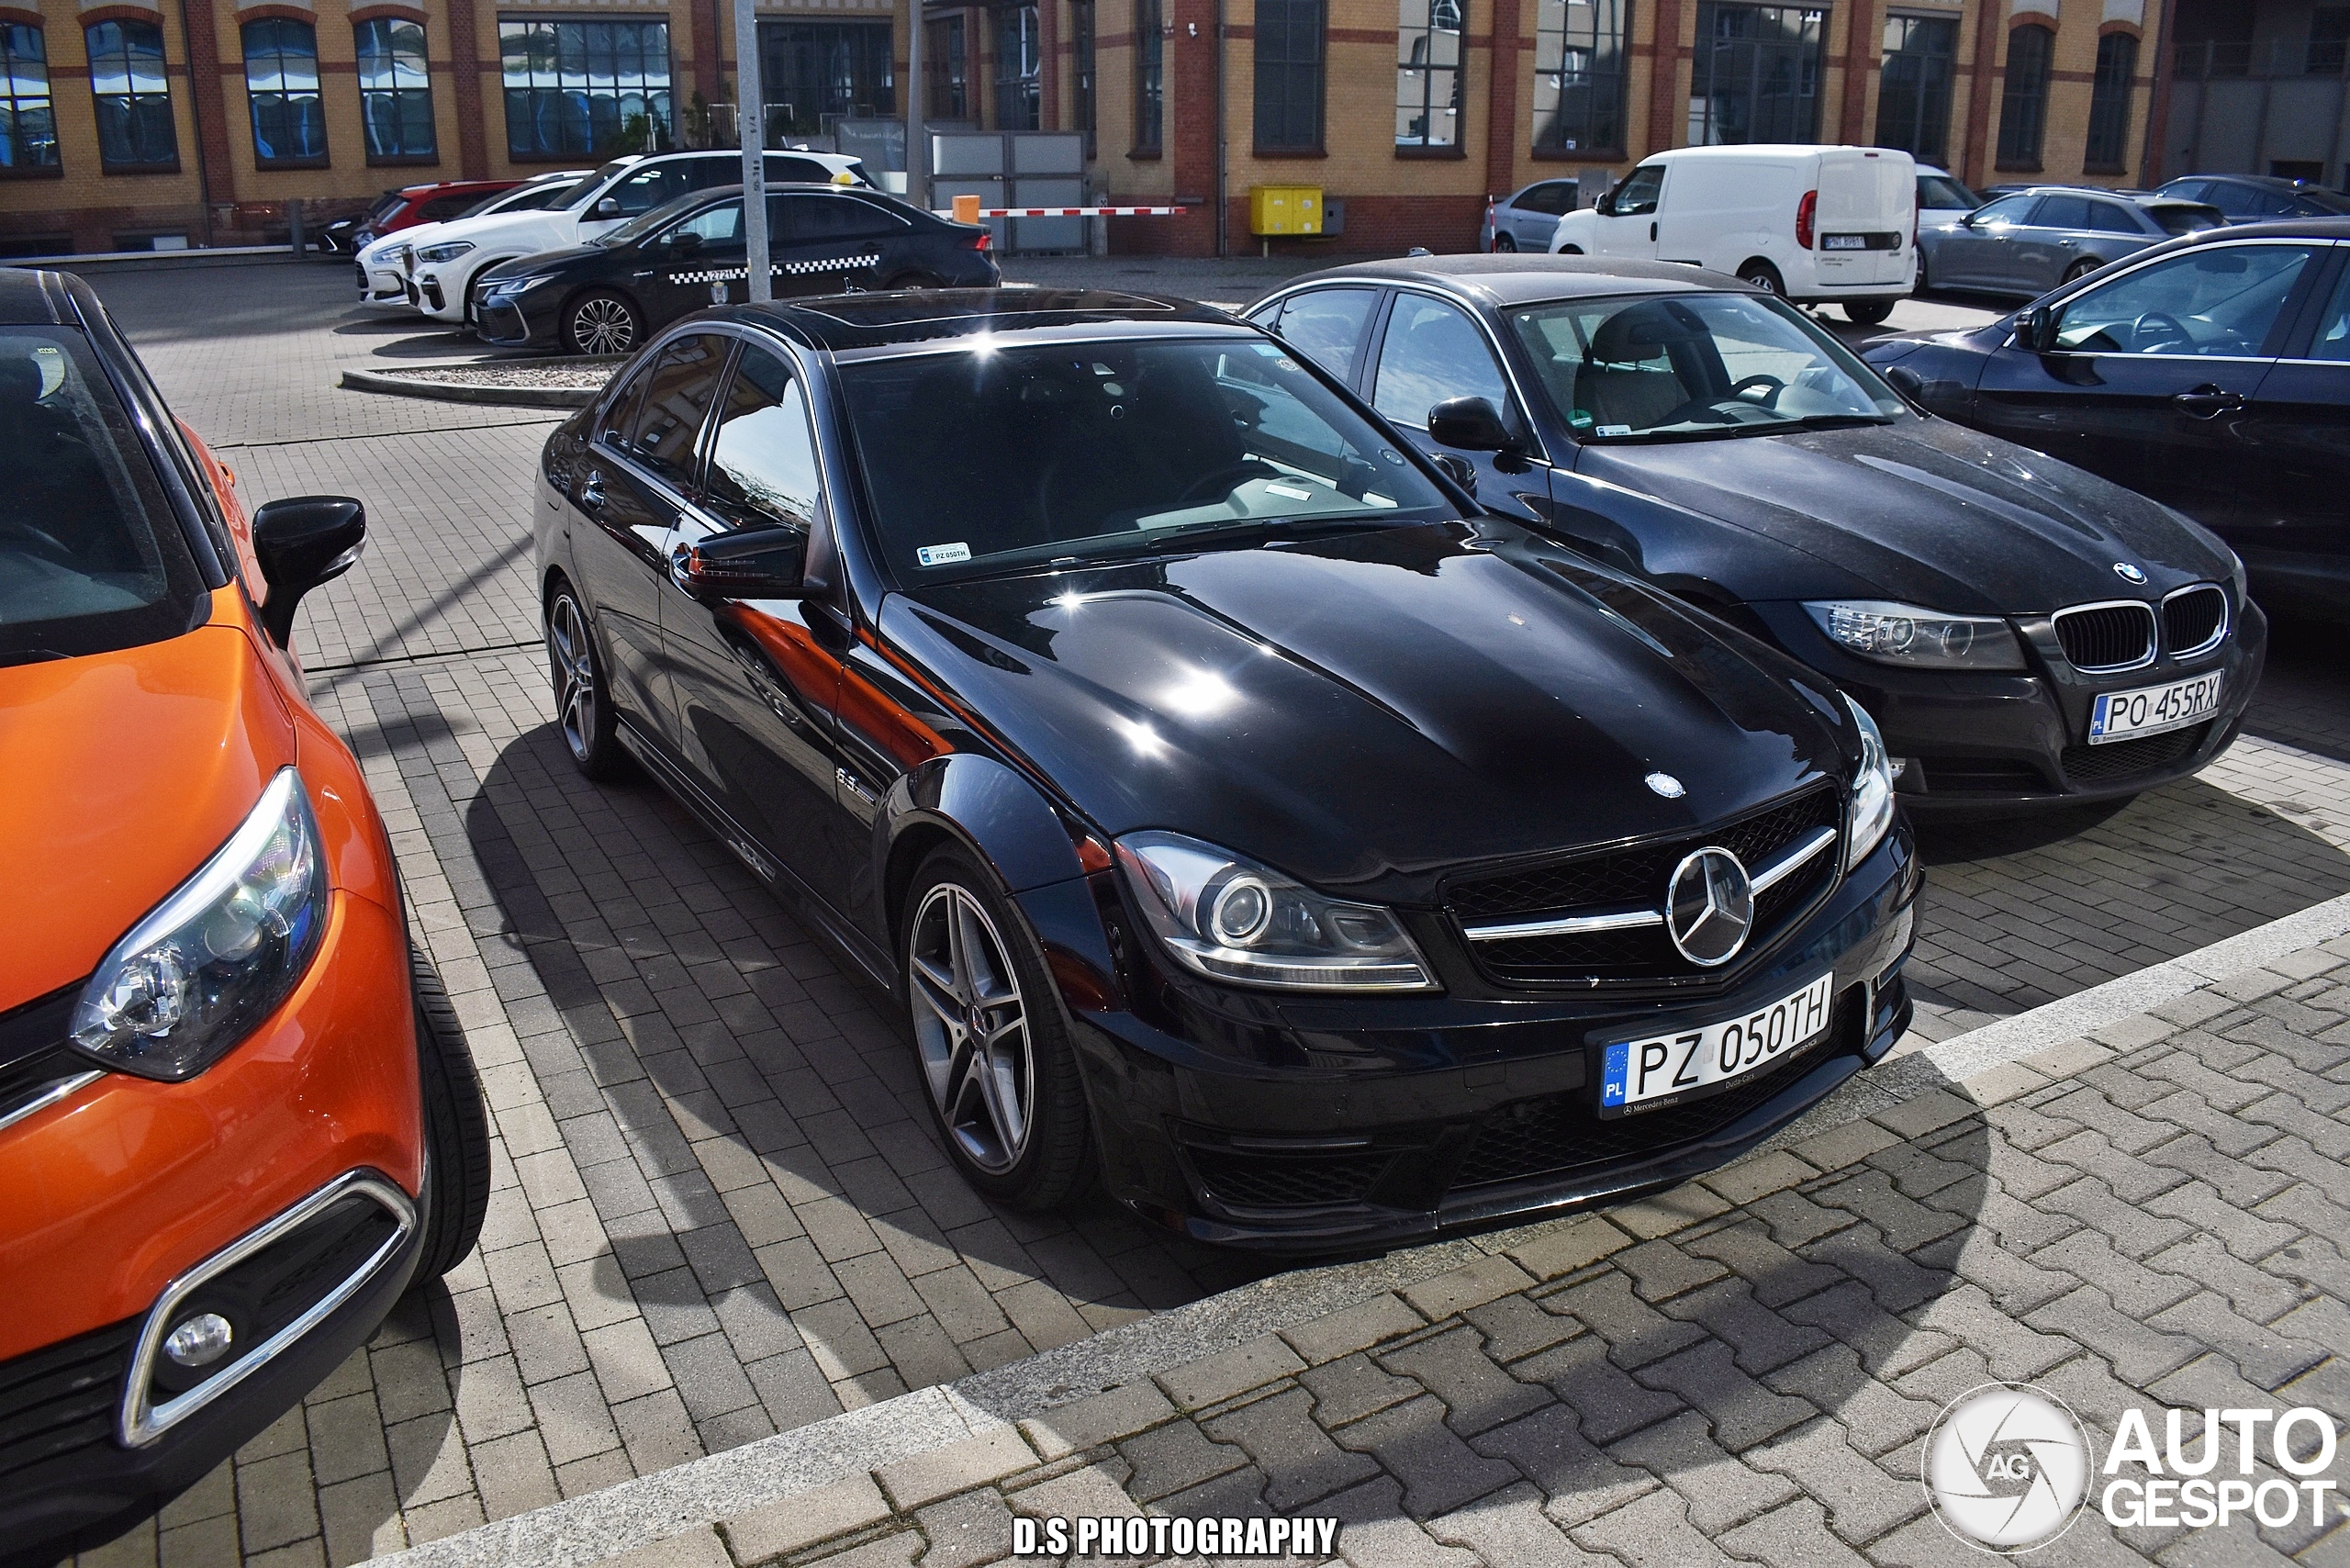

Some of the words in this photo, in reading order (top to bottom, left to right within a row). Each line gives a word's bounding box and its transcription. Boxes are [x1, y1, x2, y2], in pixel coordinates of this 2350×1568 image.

[711, 270, 731, 280] 2721
[2109, 694, 2148, 731] PO
[2154, 676, 2219, 721] 455RX
[2093, 721, 2103, 730] PL
[1638, 1033, 1703, 1094] PZ
[1719, 980, 1826, 1073] 050TH
[1725, 1072, 1755, 1089] Duda-Cars
[1606, 1083, 1623, 1098] PL
[1633, 1097, 1679, 1114] Mercedes-Benz
